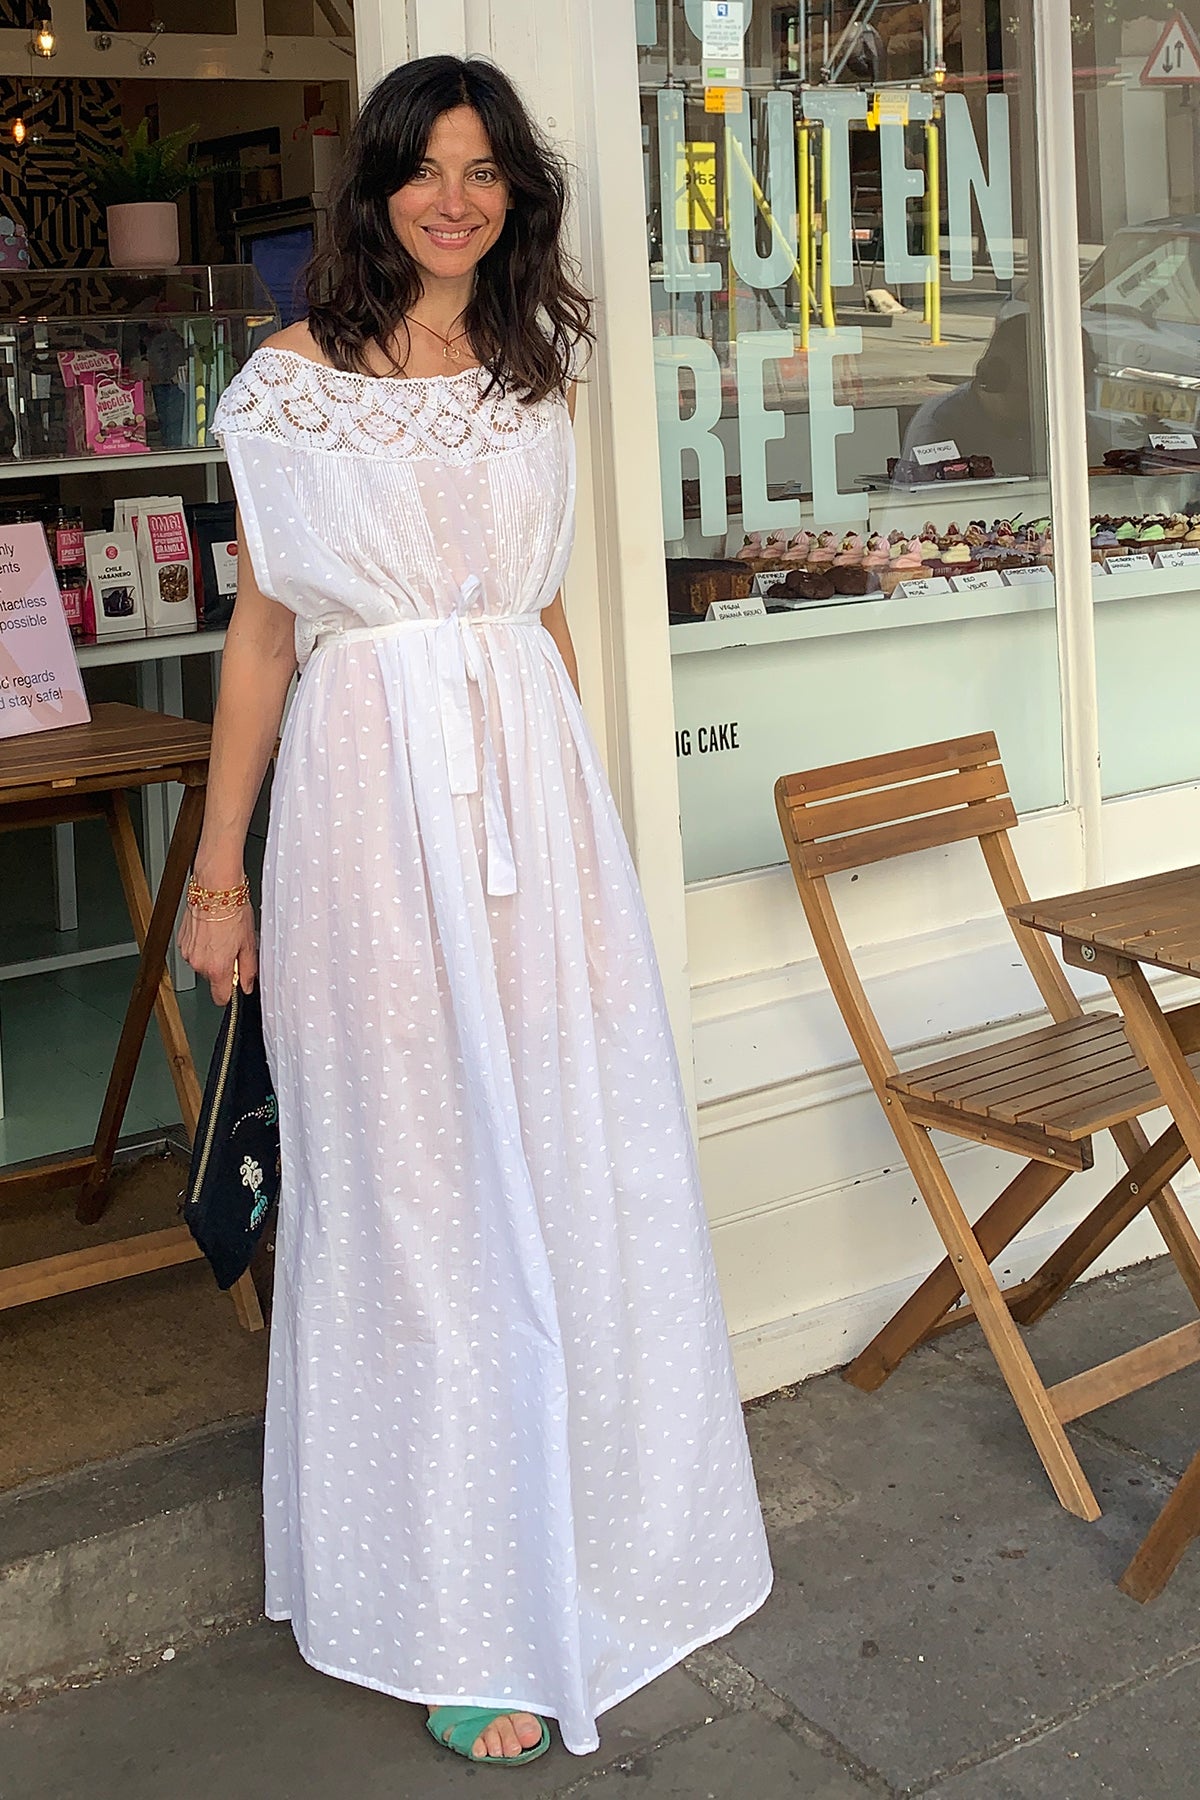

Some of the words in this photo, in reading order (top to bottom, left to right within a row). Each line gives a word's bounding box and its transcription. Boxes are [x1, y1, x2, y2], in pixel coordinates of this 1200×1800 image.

[150, 514, 182, 531] OMG!
[98, 571, 132, 580] HABANERO
[105, 565, 122, 573] CHILE
[719, 603, 740, 611] VEGAN
[0, 613, 47, 634] possible
[12, 670, 56, 689] regards
[9, 694, 33, 708] stay
[36, 687, 63, 703] safe!
[698, 722, 740, 753] CAKE
